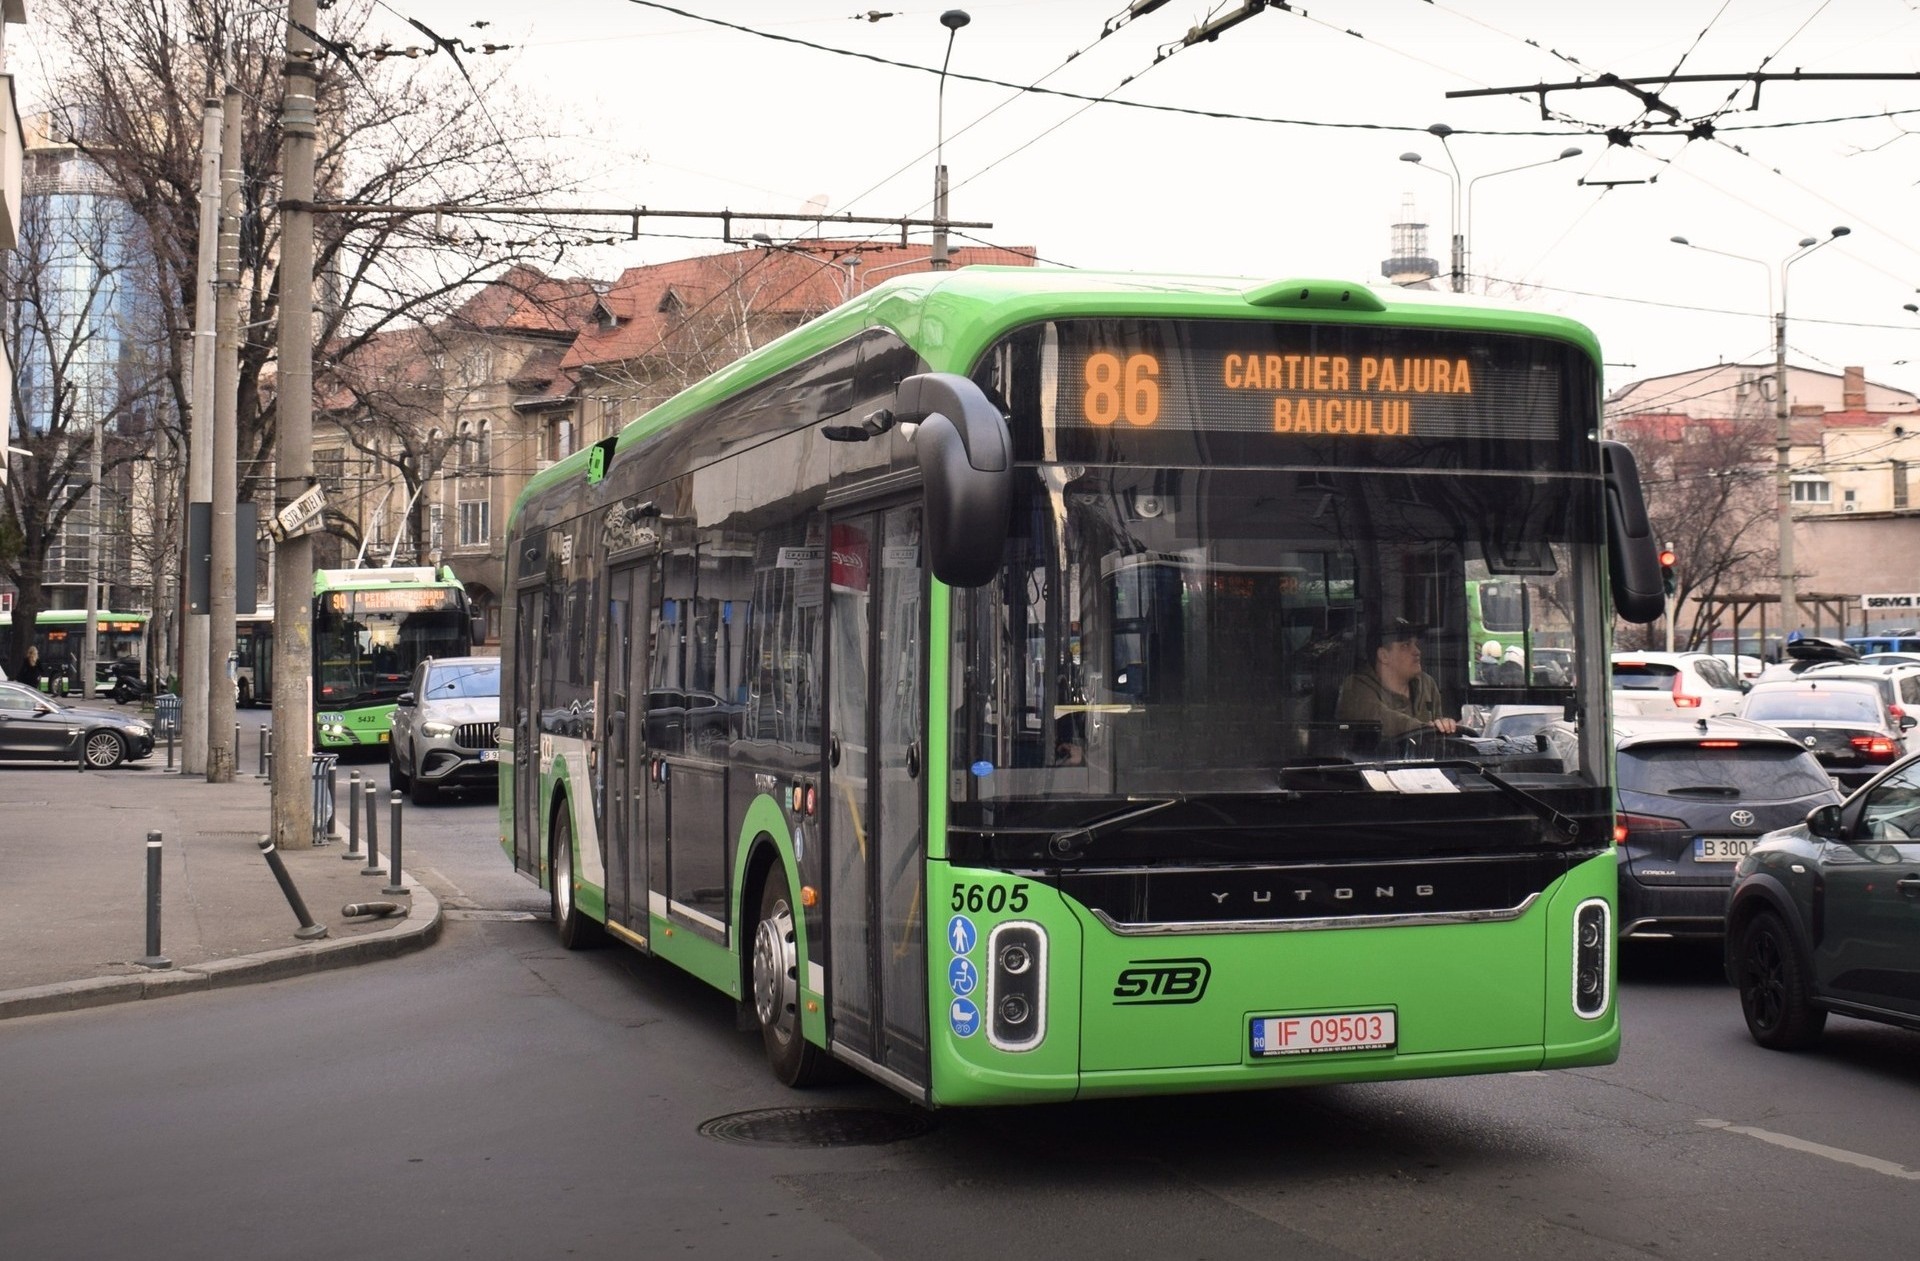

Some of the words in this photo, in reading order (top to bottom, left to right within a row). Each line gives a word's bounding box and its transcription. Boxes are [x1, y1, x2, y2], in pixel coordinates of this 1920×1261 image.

[1224, 353, 1349, 390] CARTIER
[1361, 357, 1472, 394] PAJURA
[1084, 353, 1160, 426] 86
[1273, 398, 1410, 436] BAICULUI
[332, 593, 347, 609] 90
[357, 715, 376, 723] 5432
[1704, 841, 1715, 856] B
[1720, 840, 1748, 856] 300
[951, 883, 1029, 913] 5605
[1211, 884, 1434, 904] YUTONG
[1112, 966, 1202, 998] STB
[1253, 1036, 1265, 1048] RO
[1278, 1020, 1300, 1047] IF
[1310, 1015, 1383, 1044] 09503
